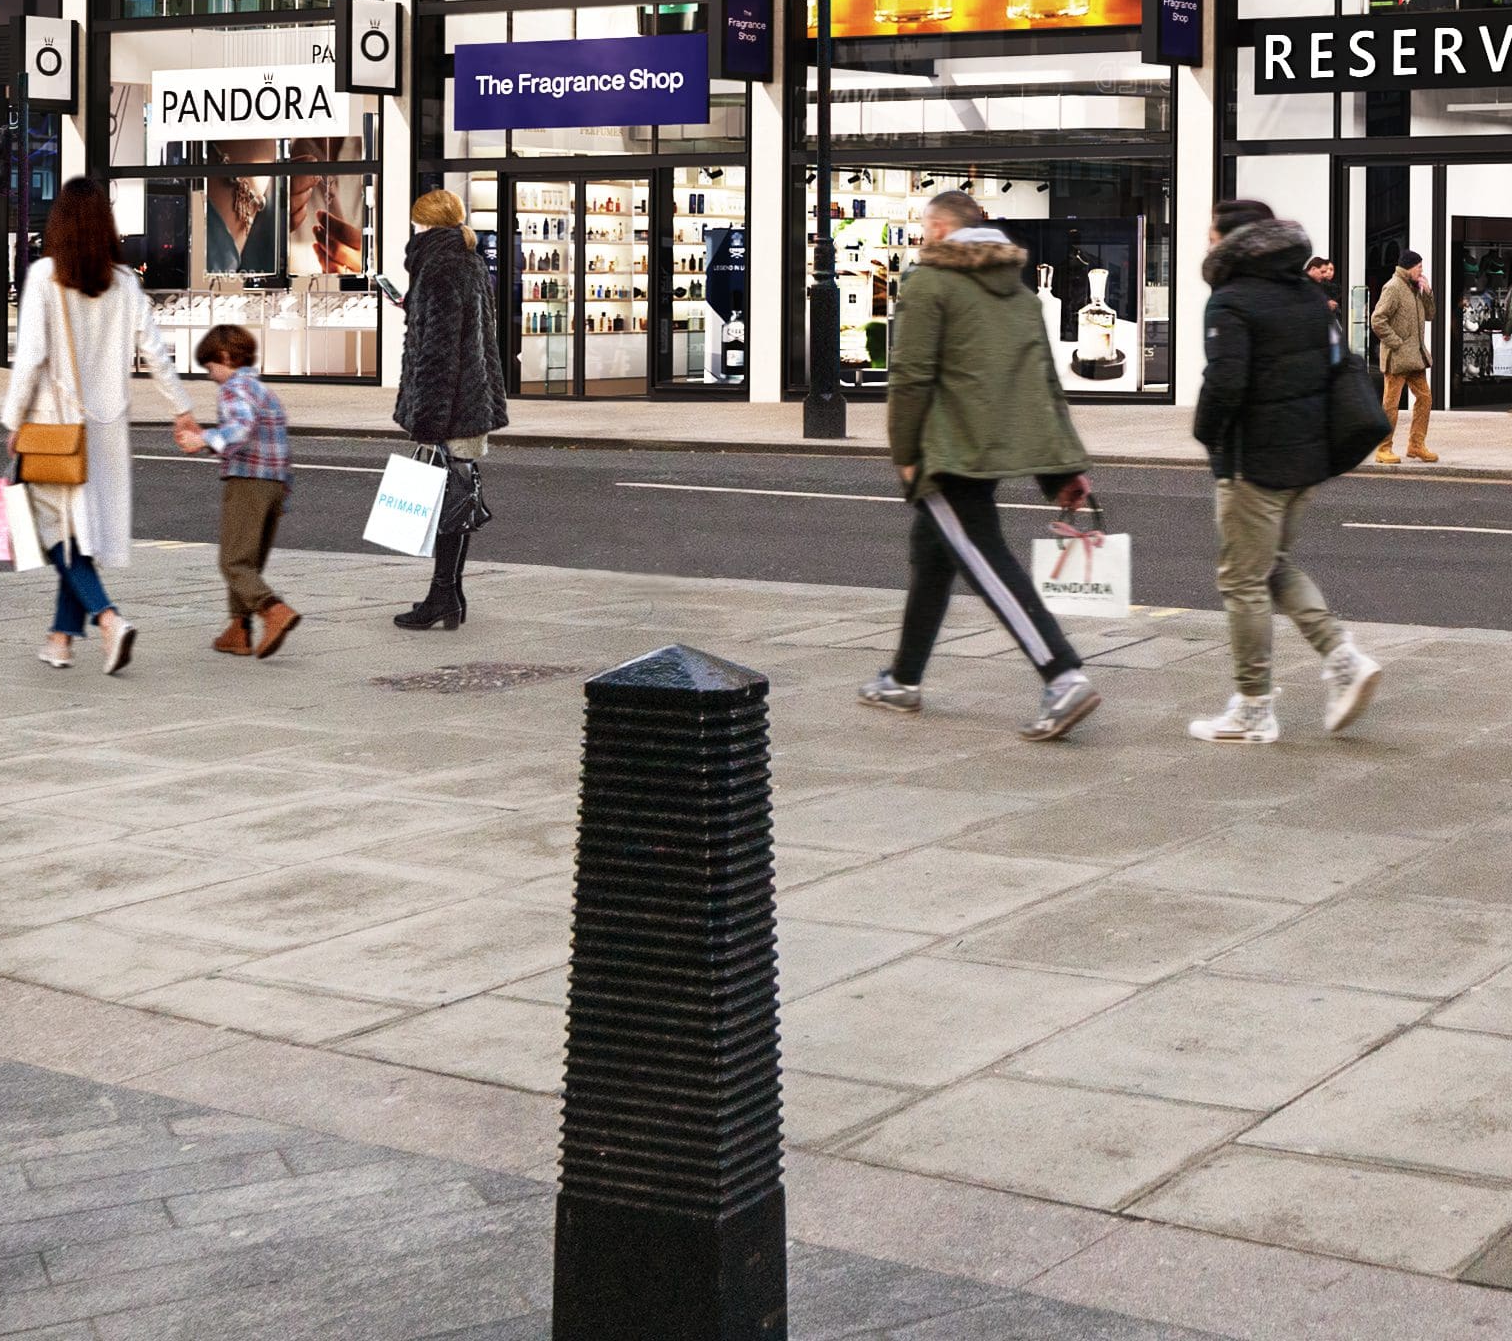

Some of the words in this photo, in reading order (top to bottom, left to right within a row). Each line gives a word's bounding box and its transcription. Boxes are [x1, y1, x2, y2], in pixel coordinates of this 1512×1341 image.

[728, 17, 767, 30] Fragrance
[1172, 12, 1189, 23] Shop
[738, 31, 757, 43] Shop
[475, 75, 513, 95] The
[518, 72, 625, 98] Fragrance
[628, 68, 684, 93] Shop
[162, 83, 334, 124] PANDORA
[378, 493, 429, 518] PRIMARK
[1042, 581, 1114, 595] PANDORA
